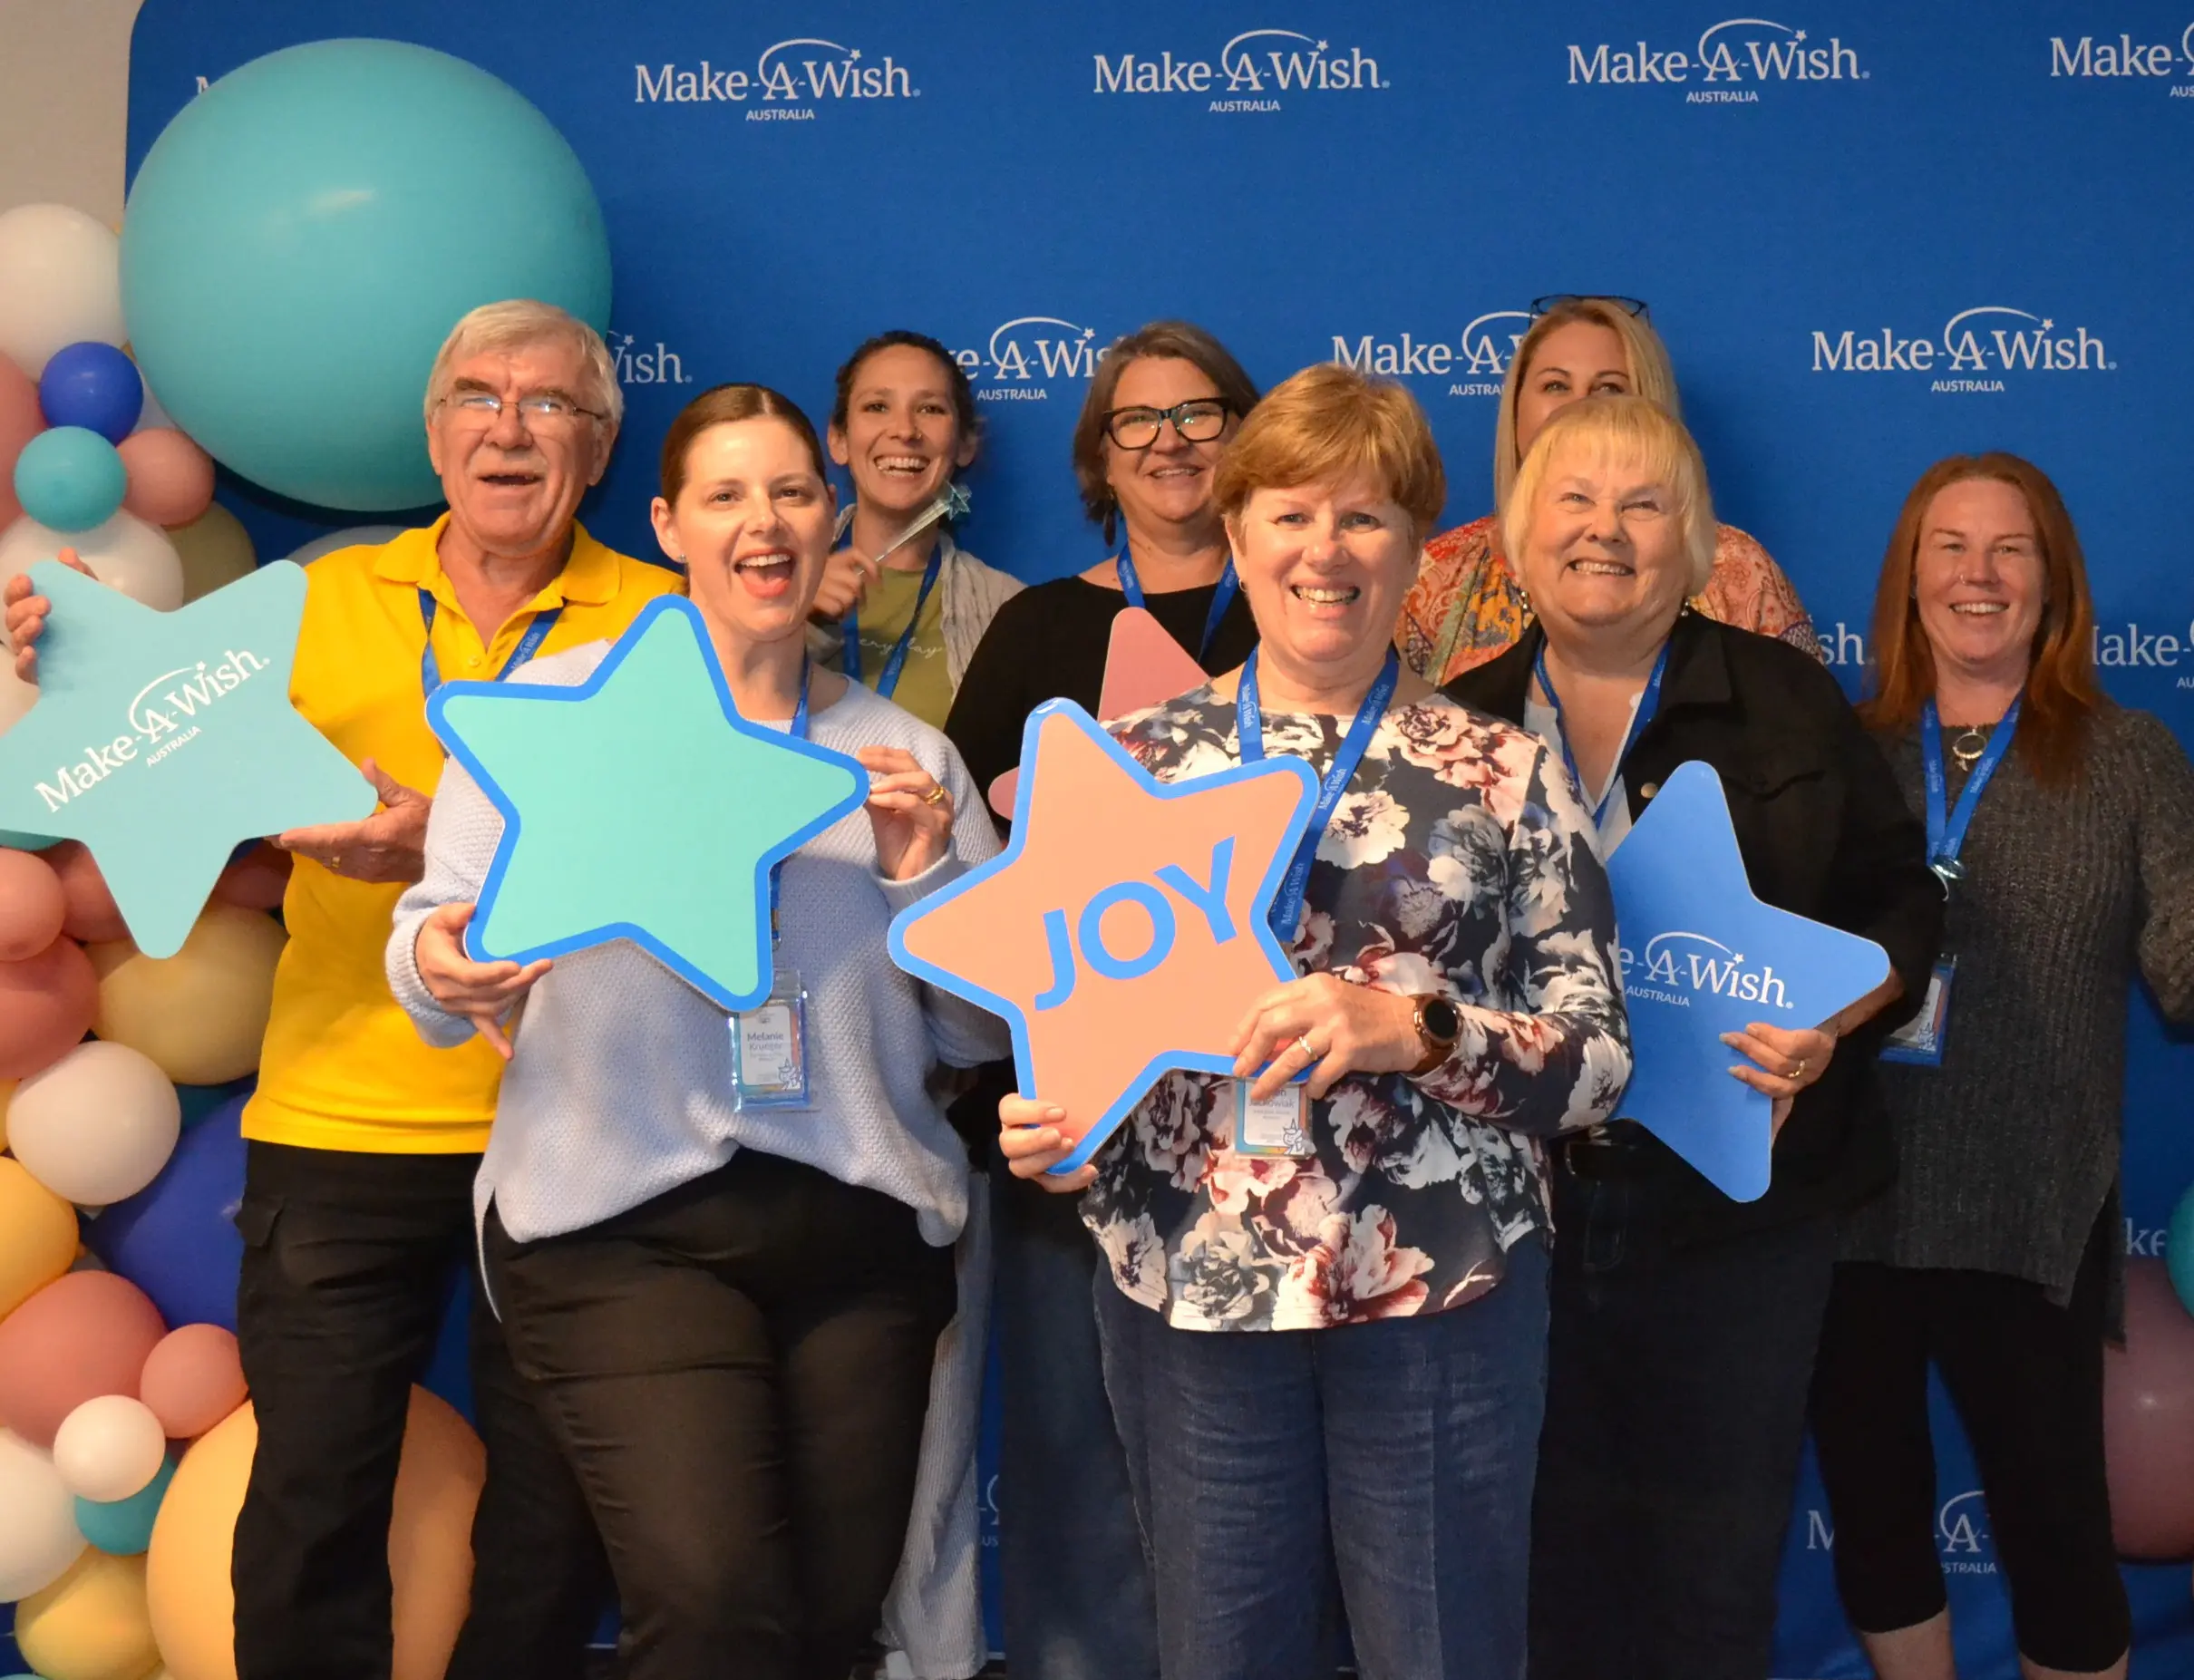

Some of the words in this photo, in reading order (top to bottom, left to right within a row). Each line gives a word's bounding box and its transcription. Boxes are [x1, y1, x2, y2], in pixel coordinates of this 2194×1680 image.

[2049, 33, 2194, 77] Make-
[1685, 91, 1759, 103] AUSTRALIA
[1209, 100, 1281, 113] AUSTRALIA
[745, 108, 815, 121] AUSTRALIA
[1449, 383, 1505, 396] AUSTRA
[1931, 380, 2005, 393] AUSTRALIA
[976, 388, 1047, 401] AUSTRALIA
[146, 725, 201, 767] AUSTRALIA
[1034, 834, 1238, 1011] JOY
[1625, 985, 1690, 1007] AUSTRALIA
[747, 1032, 784, 1042] Melanie
[1940, 1561, 1997, 1575] STRALIA
